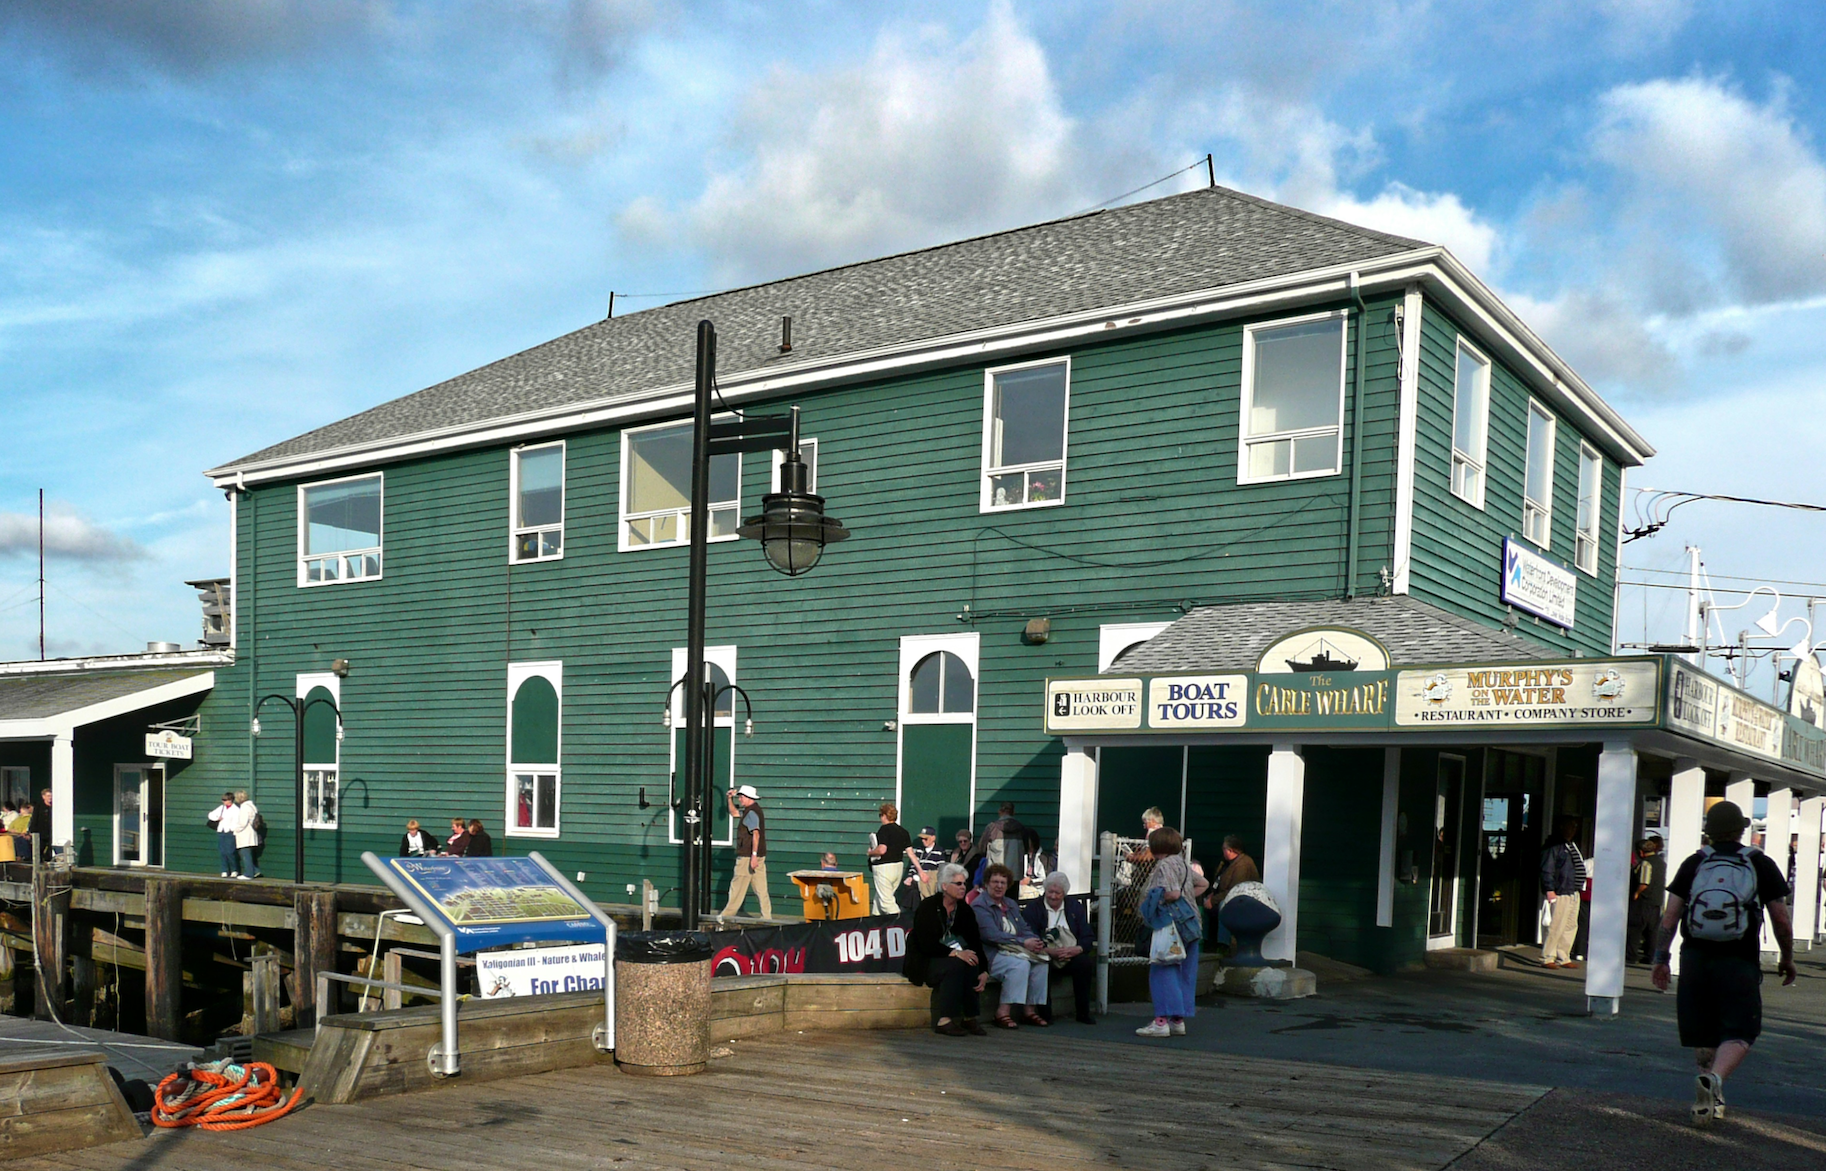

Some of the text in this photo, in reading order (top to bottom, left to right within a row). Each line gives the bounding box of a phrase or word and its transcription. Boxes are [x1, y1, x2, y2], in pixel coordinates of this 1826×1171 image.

[1310, 674, 1332, 686] The
[1467, 668, 1573, 688] MURPHY'S
[1073, 692, 1136, 703] HARBOUR
[1167, 683, 1230, 701] BOAT
[1256, 679, 1388, 716] CABLE WHARF
[1471, 689, 1489, 698] ON
[1492, 688, 1567, 705] WATER
[1471, 698, 1490, 706] THE
[1073, 704, 1136, 716] LOOK OFF
[1157, 701, 1238, 720] TOURS
[1421, 707, 1625, 721] RESTAURANT COMPANY STORE
[834, 926, 911, 963] 104 D
[542, 954, 570, 965] Nature
[572, 955, 578, 963] &
[530, 977, 560, 995] For
